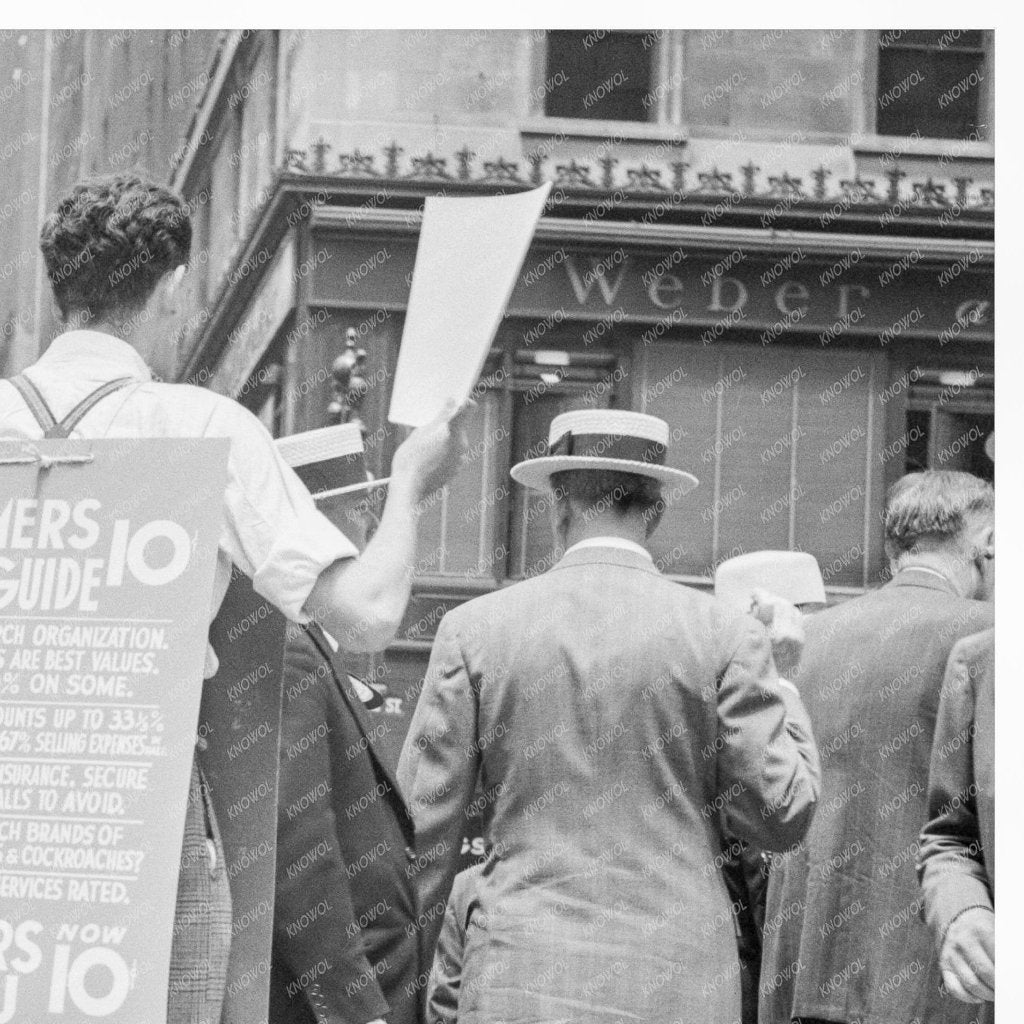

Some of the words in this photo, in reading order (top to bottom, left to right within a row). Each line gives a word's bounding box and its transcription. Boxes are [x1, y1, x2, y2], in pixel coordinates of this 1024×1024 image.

[565, 257, 871, 319] Weber
[32, 624, 169, 650] ORGANIZATION.
[9, 649, 40, 670] ARE
[44, 650, 86, 671] BEST
[91, 652, 160, 675] VALUES.
[29, 674, 61, 694] ON
[65, 675, 134, 698] SOME.
[53, 708, 76, 729] UP
[81, 709, 104, 730] TO
[35, 732, 87, 754] SELLING
[82, 766, 149, 790] SECURE
[38, 789, 57, 812] TO
[61, 791, 125, 815] AVOID.
[26, 822, 95, 845] BRANDS
[98, 824, 125, 846] OF
[6, 847, 18, 865] &
[21, 845, 145, 873] COCKROACHES?
[67, 879, 130, 905] RATED.
[56, 922, 127, 945] NOW
